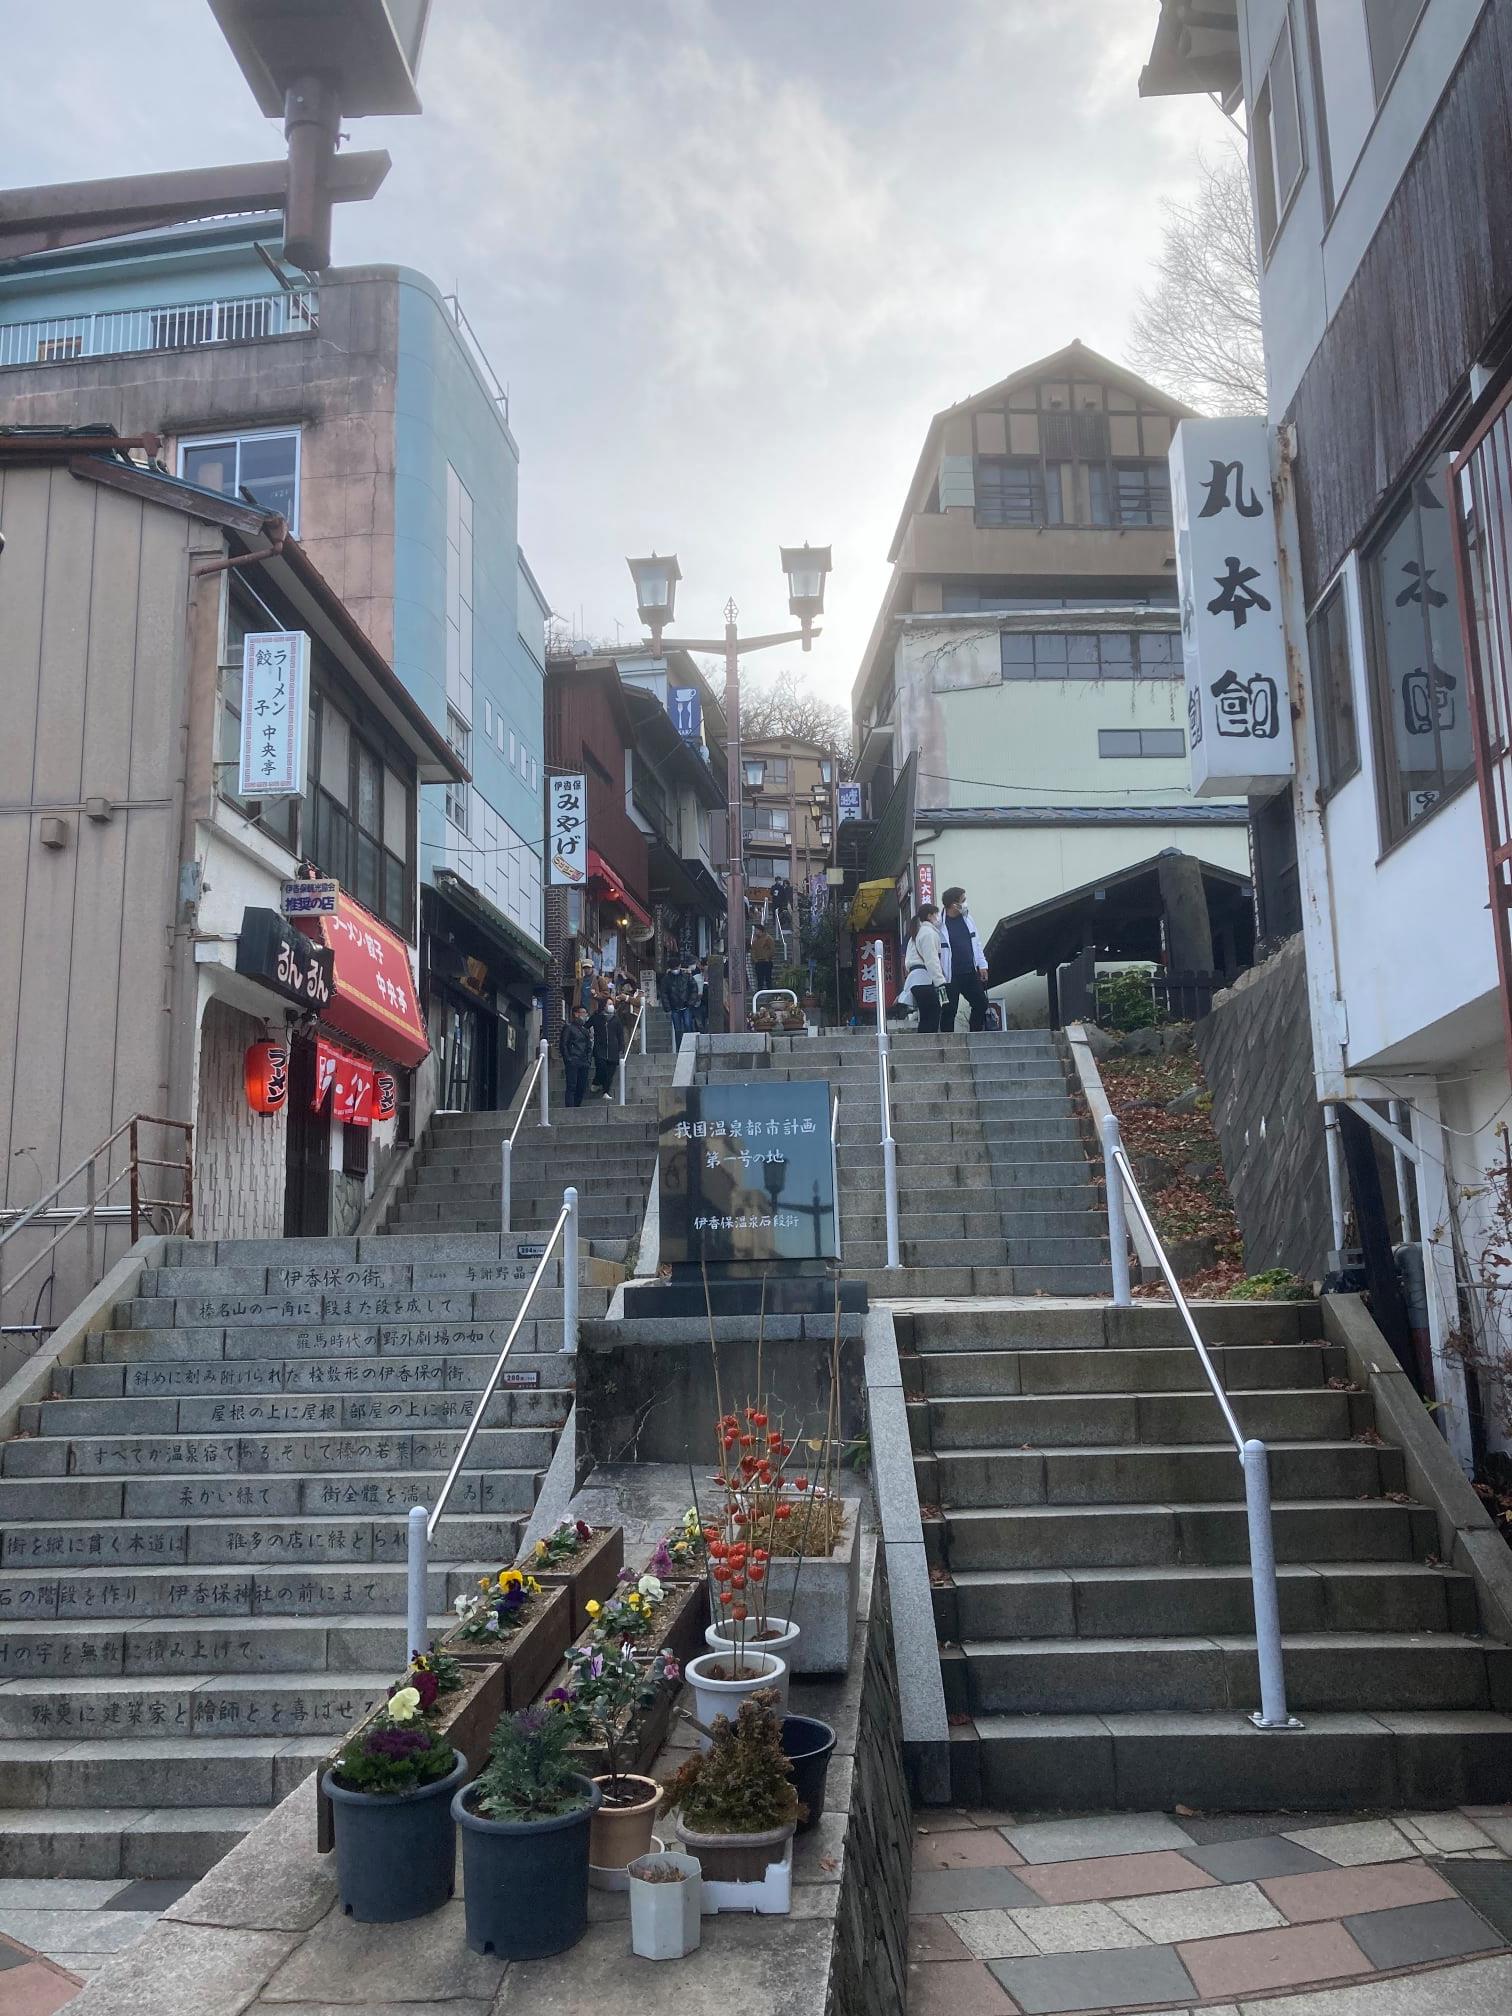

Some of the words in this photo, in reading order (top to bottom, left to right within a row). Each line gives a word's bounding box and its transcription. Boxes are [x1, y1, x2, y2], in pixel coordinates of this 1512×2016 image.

[254, 650, 272, 716] 餃子
[272, 650, 287, 716] ラーメン
[261, 725, 276, 776] 中央亭
[554, 781, 581, 791] 伊香保
[557, 794, 581, 854] みやげ
[285, 896, 335, 911] 推奨の店
[267, 1048, 286, 1103] ラーメン
[378, 1075, 394, 1114] ラーメン
[674, 1118, 817, 1139] 我国温泉都市計画
[706, 1150, 784, 1169] 第一号の地
[694, 1214, 800, 1230] 伊香保温泉石段街
